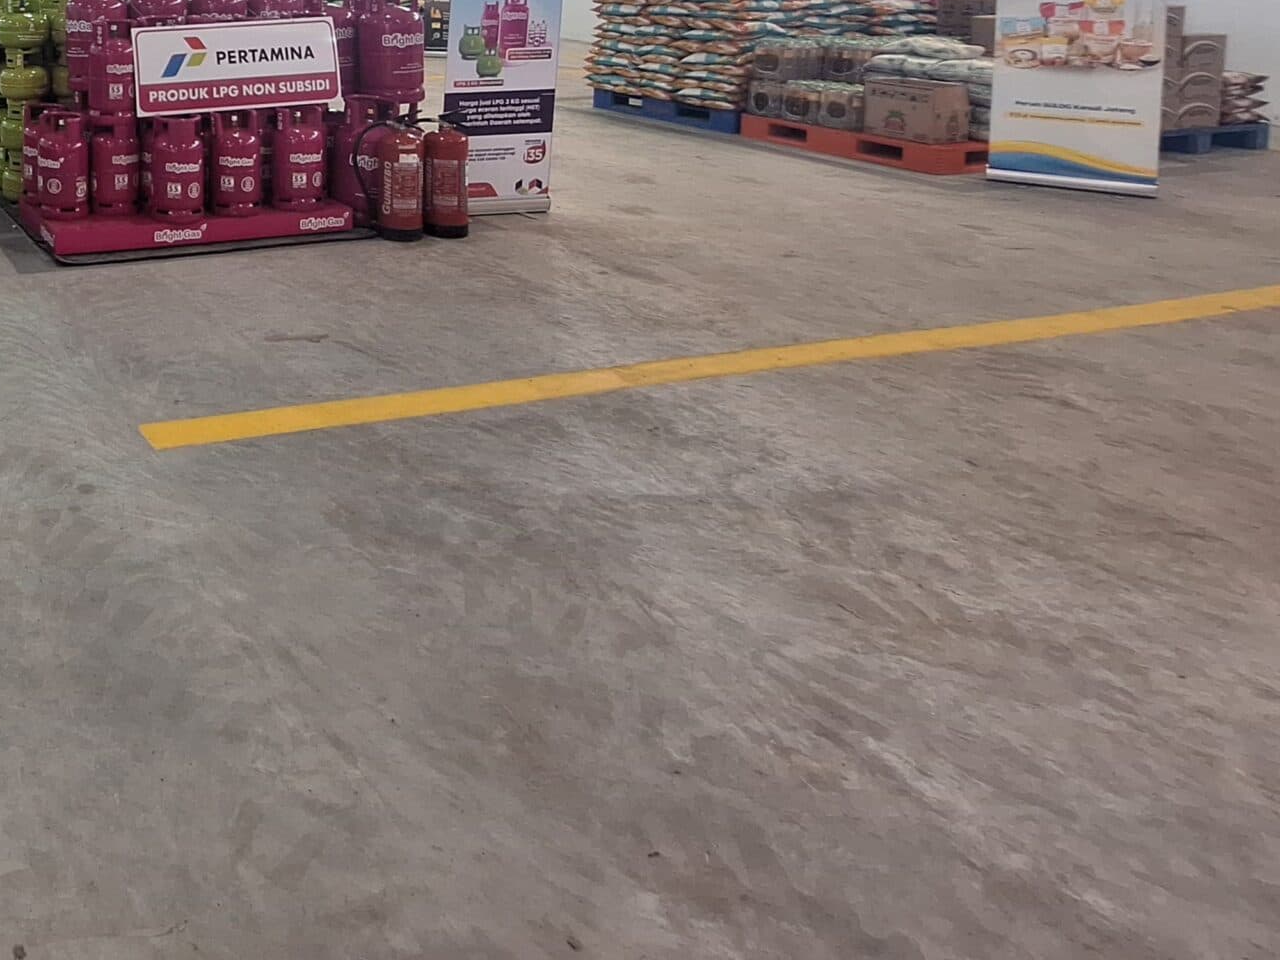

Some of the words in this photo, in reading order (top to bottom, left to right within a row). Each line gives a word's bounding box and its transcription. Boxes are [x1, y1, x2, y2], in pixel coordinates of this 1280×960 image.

[382, 33, 414, 48] Bright
[216, 45, 314, 65] PERTAMINA
[149, 88, 208, 103] PRODUK
[213, 85, 238, 98] LPG
[242, 82, 275, 96] NON
[279, 79, 330, 94] SUBSIDI
[382, 161, 393, 214] GUNNEBO
[300, 217, 327, 230] Bright
[327, 217, 344, 227] Gas
[154, 229, 183, 243] Bright
[183, 229, 202, 240] Gas
